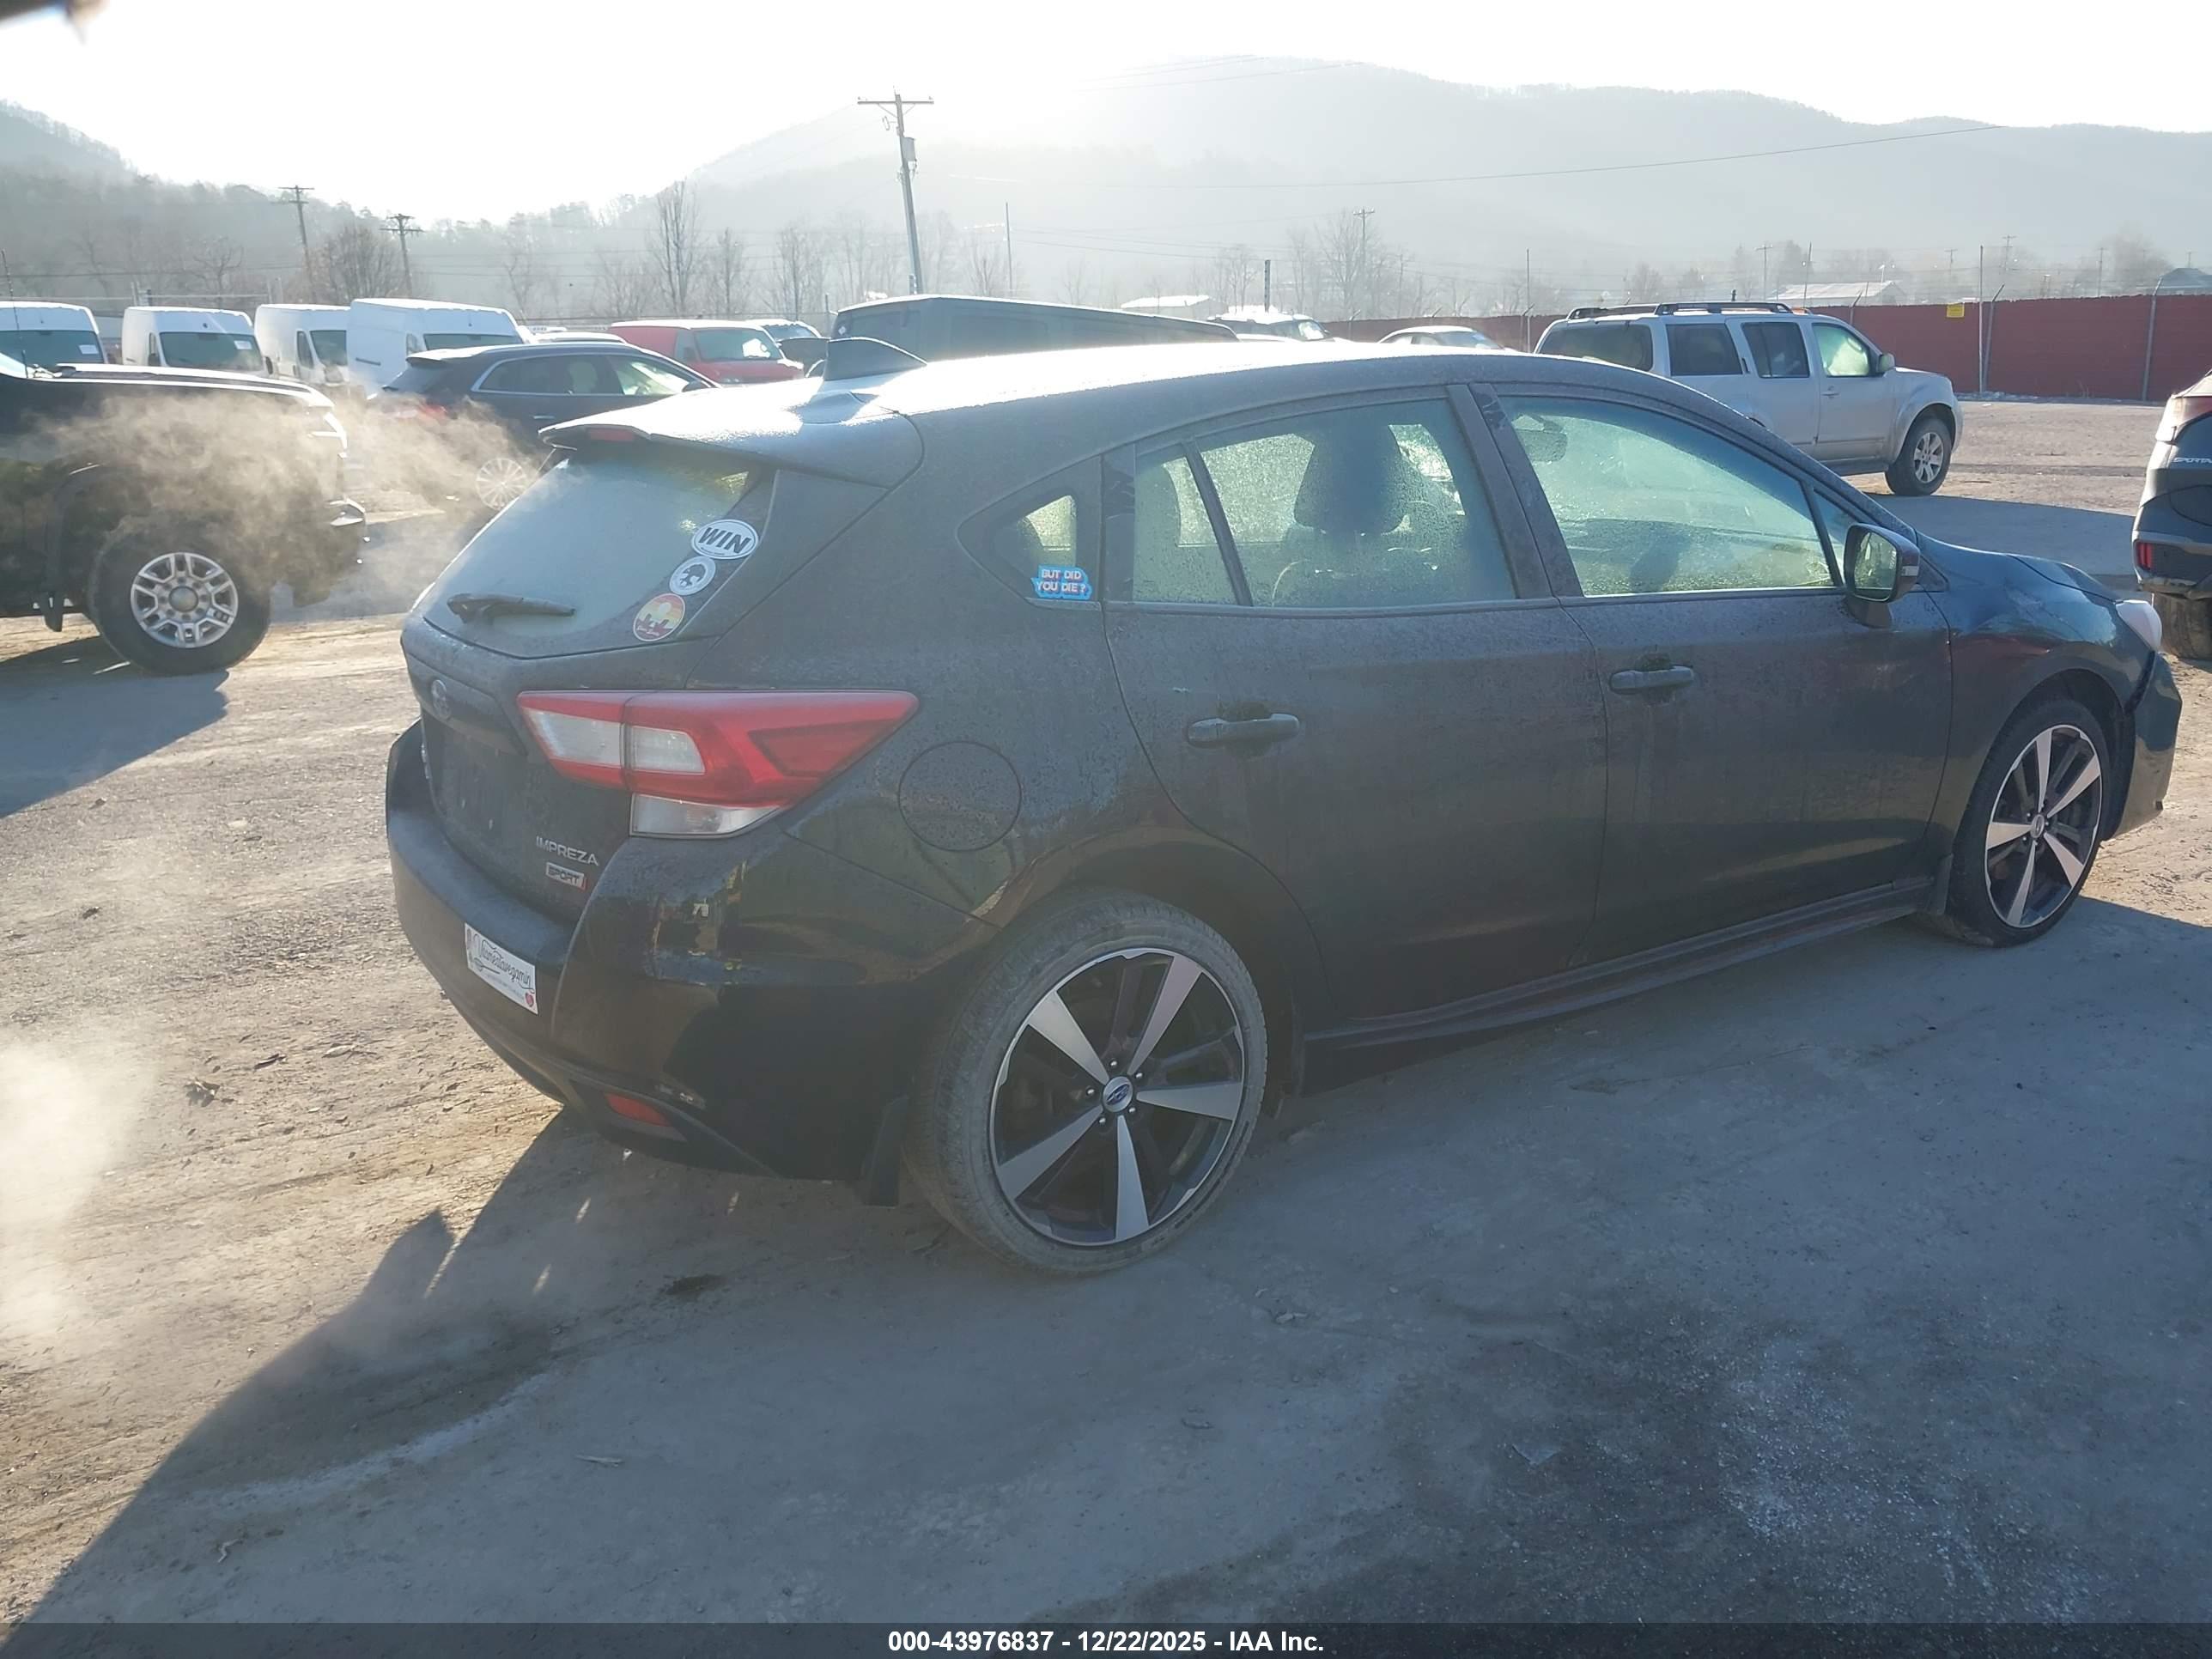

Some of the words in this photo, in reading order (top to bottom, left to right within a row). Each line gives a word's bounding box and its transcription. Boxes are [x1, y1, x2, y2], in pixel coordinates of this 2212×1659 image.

[698, 526, 751, 554] WIN
[1042, 568, 1061, 579] BUT
[1064, 570, 1082, 580] DID
[1036, 580, 1059, 592] YOU
[536, 836, 599, 866] IMPREZA
